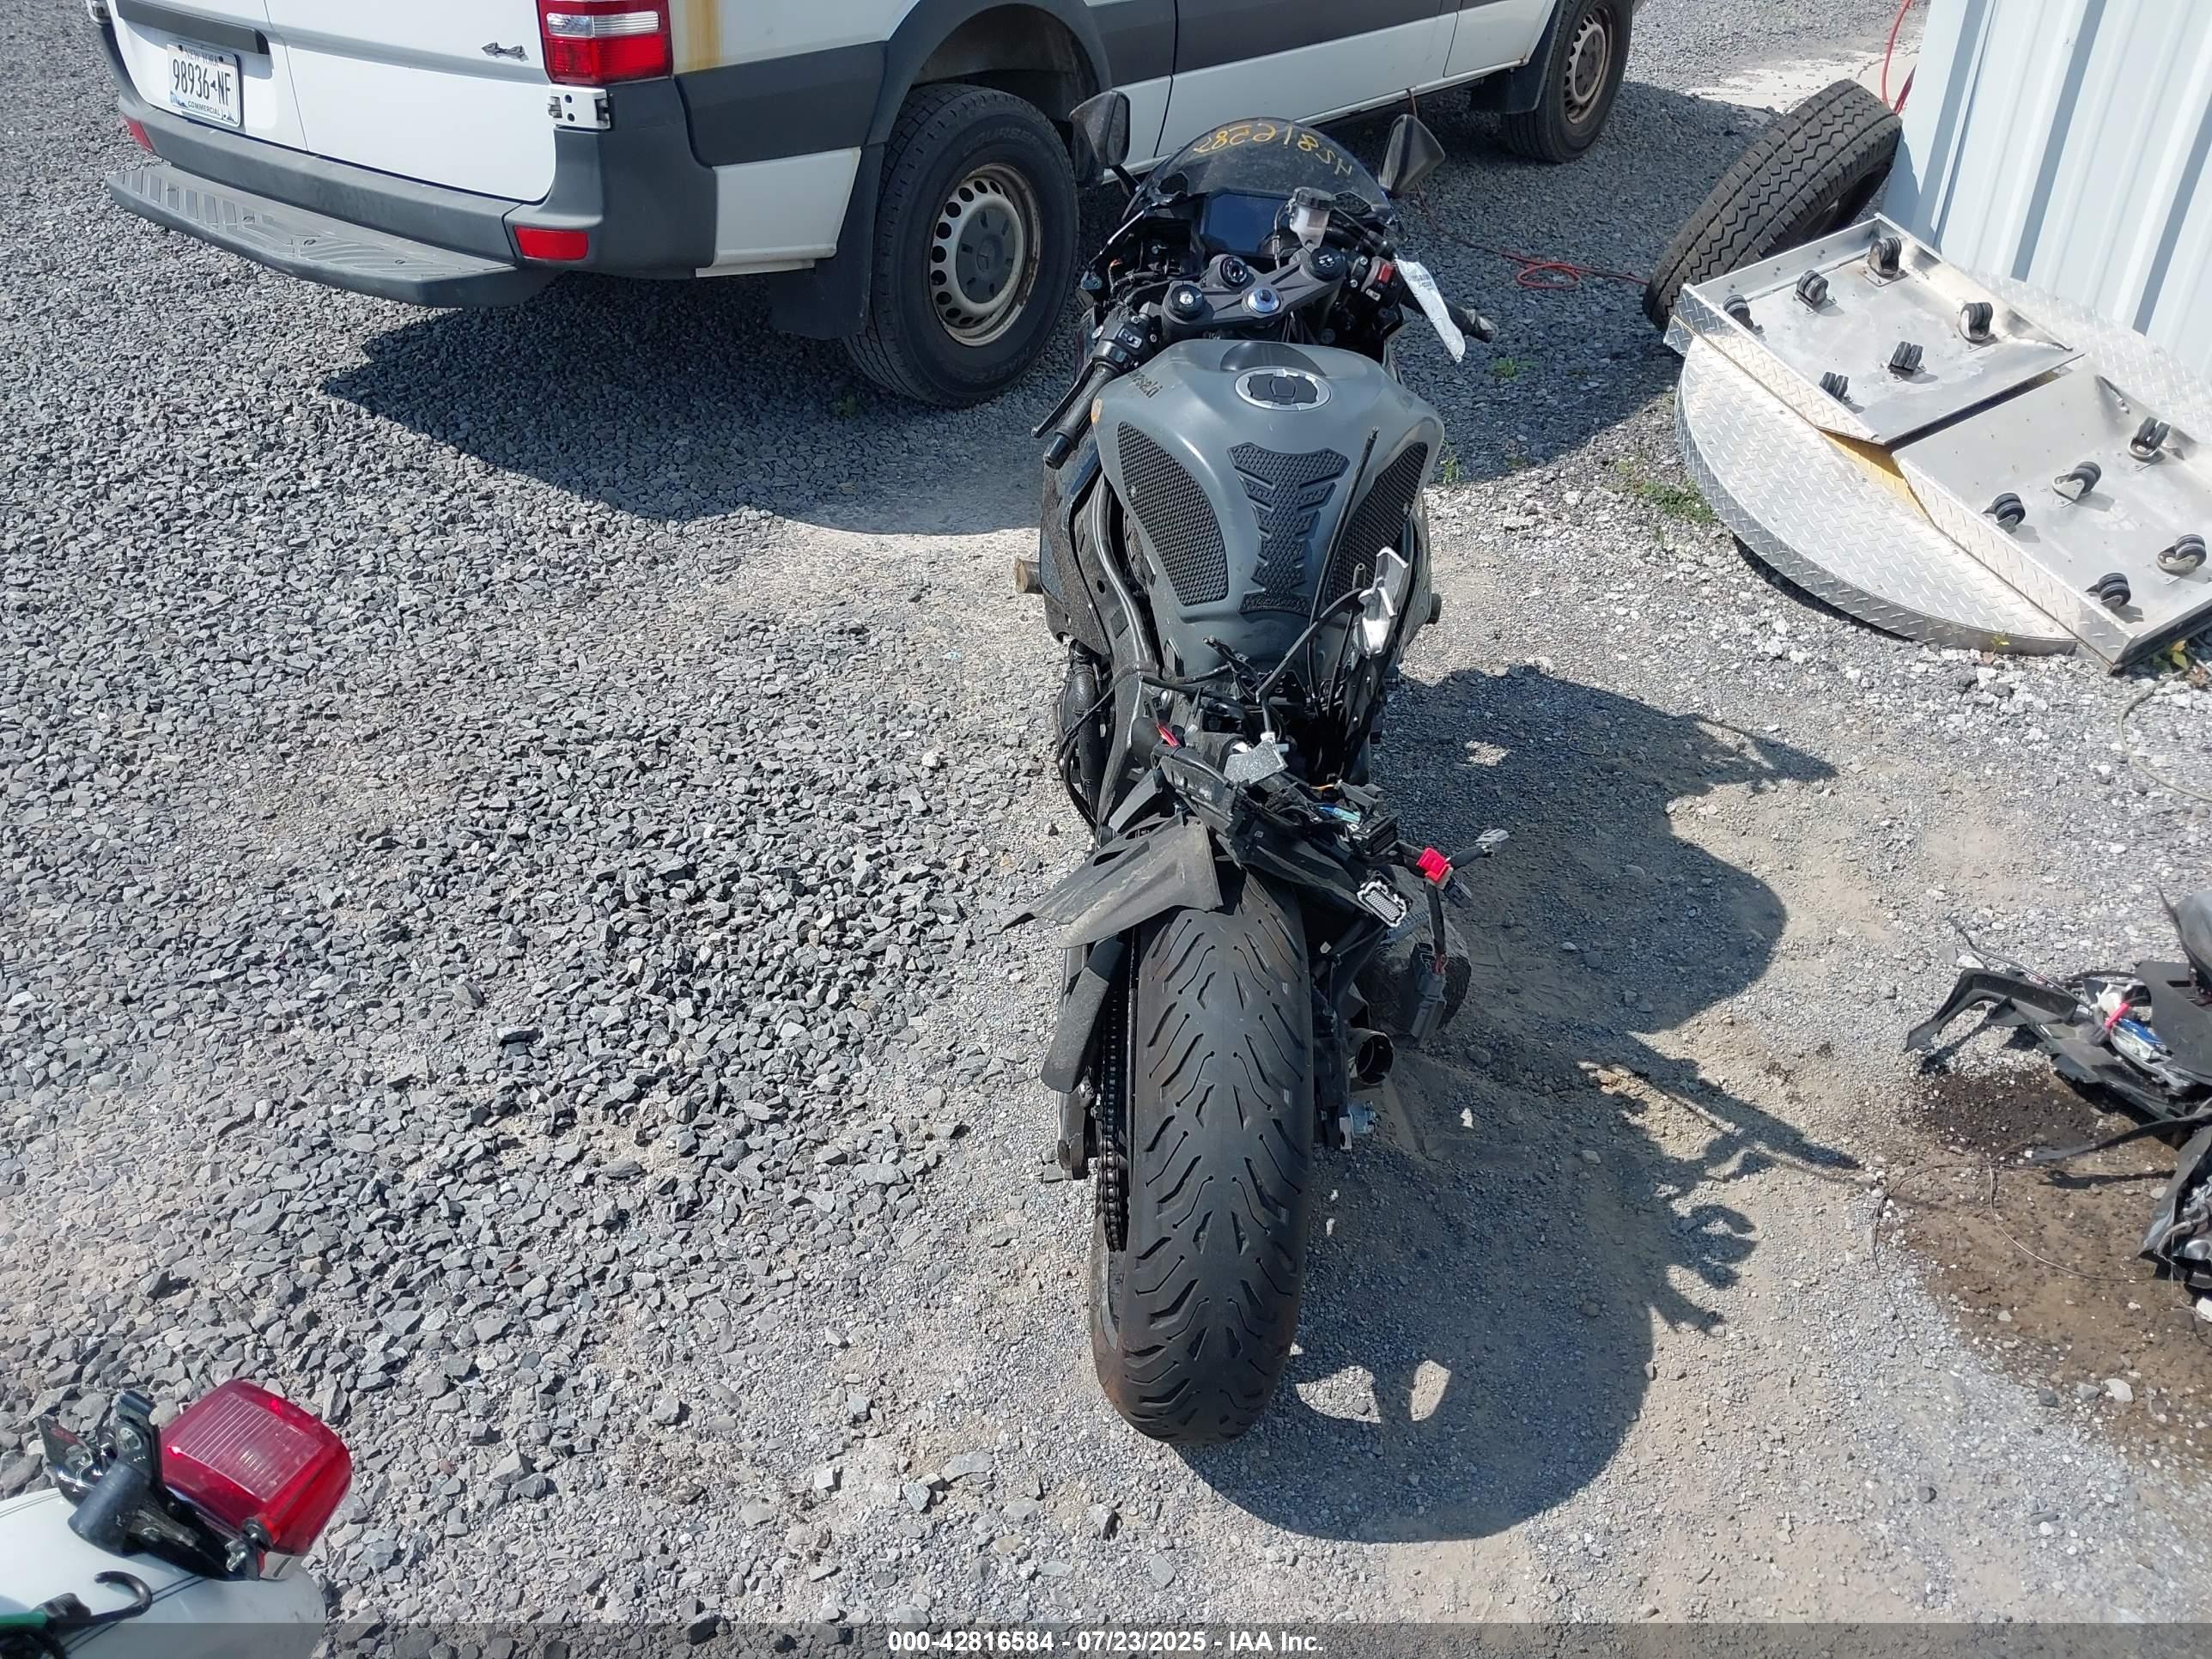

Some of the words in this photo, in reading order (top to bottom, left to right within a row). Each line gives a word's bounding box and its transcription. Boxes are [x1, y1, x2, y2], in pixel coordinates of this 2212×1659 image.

[185, 48, 200, 61] NEW
[202, 52, 220, 67] YORK
[173, 58, 210, 100] 98936
[217, 70, 230, 106] NF
[187, 100, 221, 116] COMMERCIAL
